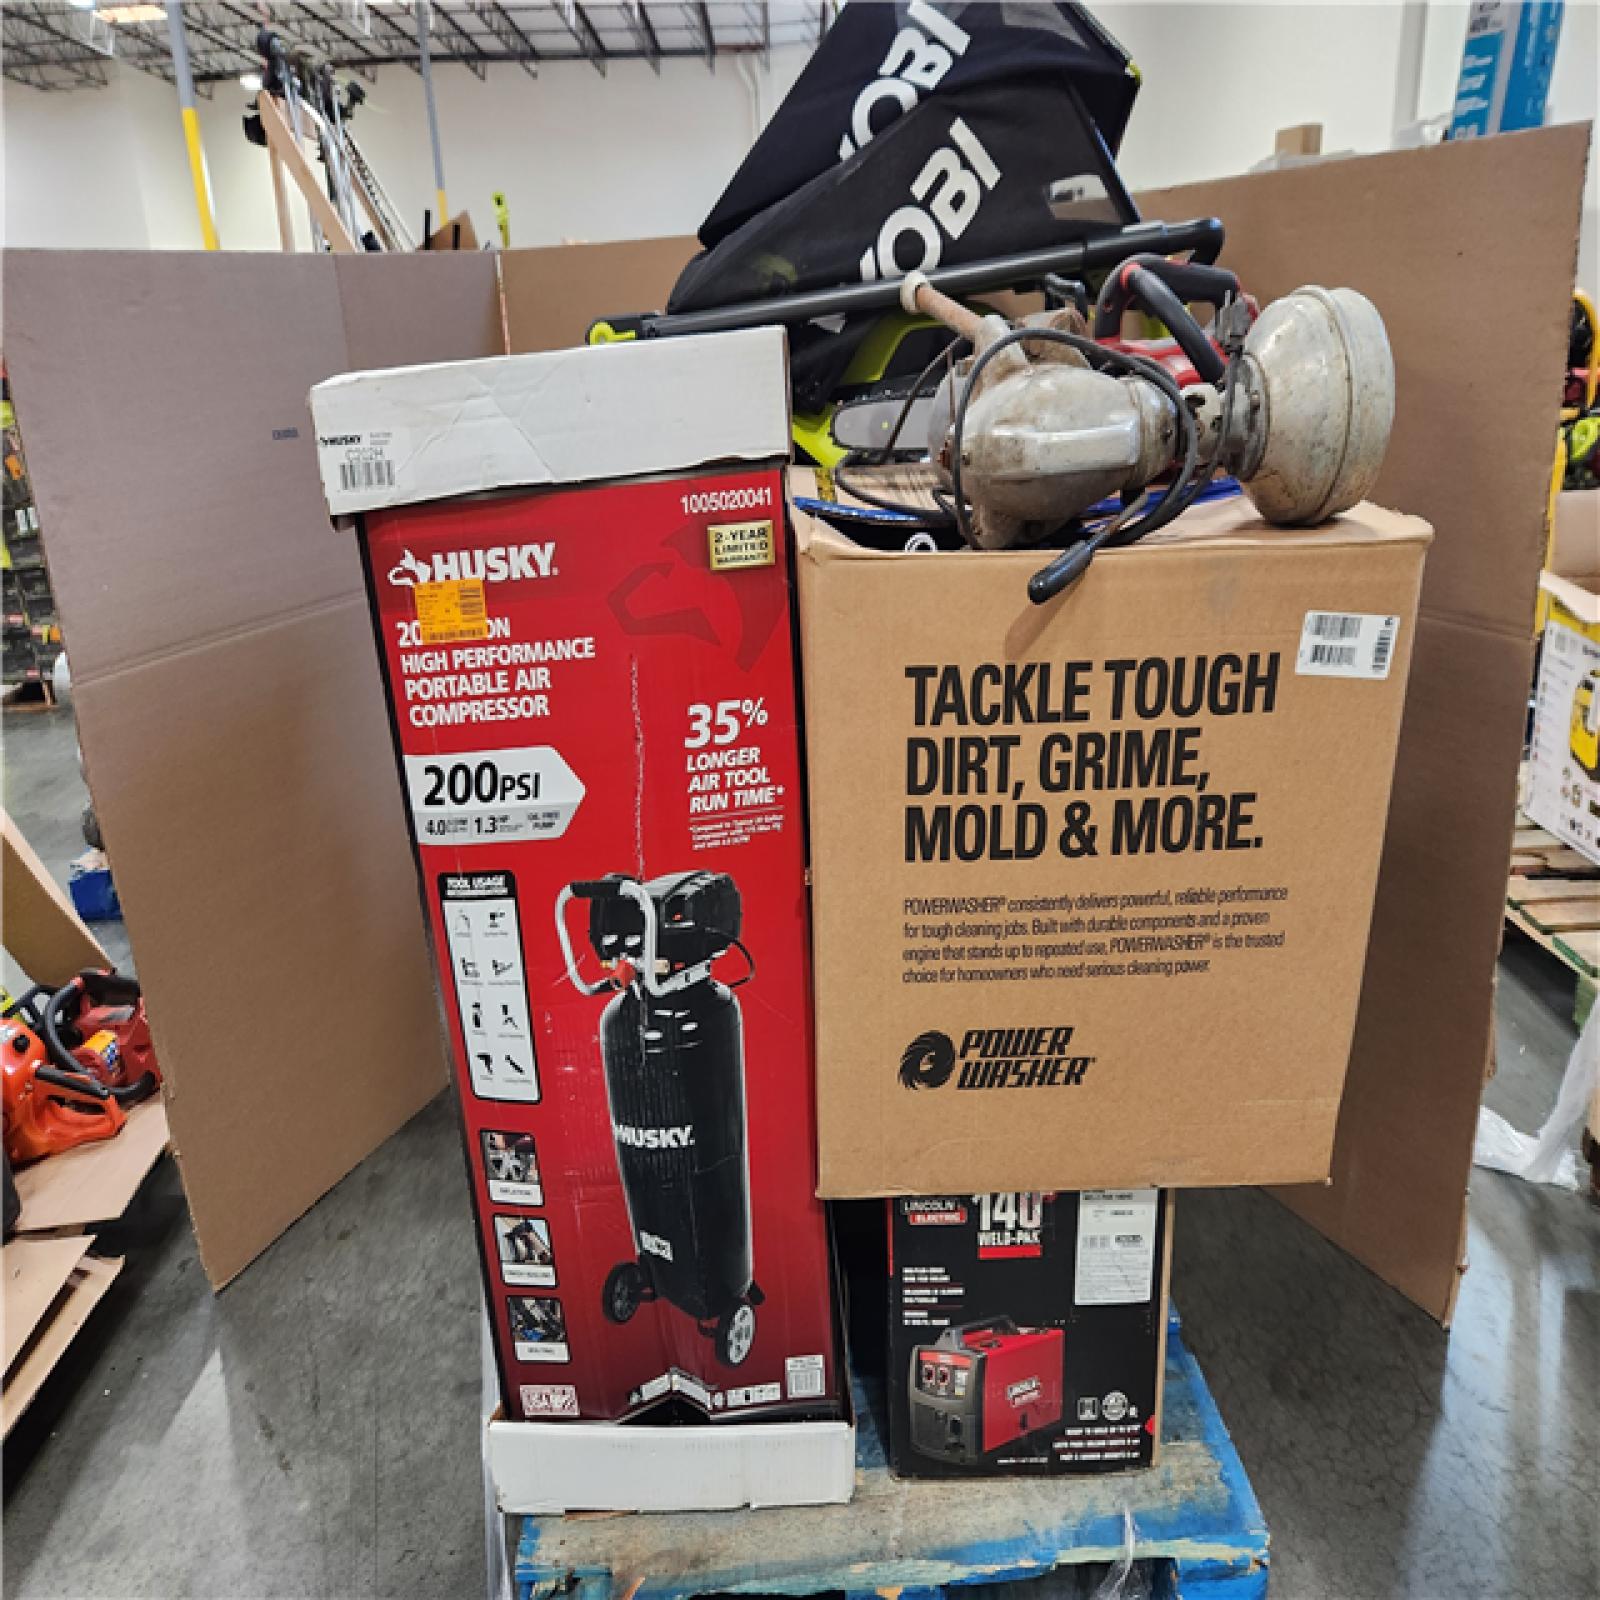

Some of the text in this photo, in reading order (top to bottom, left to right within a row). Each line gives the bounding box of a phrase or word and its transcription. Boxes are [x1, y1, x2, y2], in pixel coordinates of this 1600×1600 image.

[840, 1, 971, 161] OBI
[860, 117, 1001, 281] OBI
[681, 487, 772, 515] 1005020041
[714, 527, 768, 543] 2-YEAR
[714, 541, 768, 555] LIMITED
[432, 542, 556, 582] HUSKY
[400, 637, 596, 673] HIGH PERFORMANCE
[404, 667, 552, 701] PORTABLE AIR
[904, 652, 1281, 727] TACKLE TOUGH
[409, 694, 551, 726] COMPRESSOR
[684, 696, 769, 748] 35%
[687, 746, 761, 772] LONGER
[905, 727, 1210, 801] DIRT, GRIME,
[687, 767, 771, 793] AIR TOOL
[689, 792, 729, 814] RUN
[474, 815, 496, 836] 1.3
[903, 791, 1264, 863] MOLD & MORE.
[1007, 894, 1073, 912] consistently
[1074, 891, 1118, 908] delivers
[1174, 887, 1216, 906] reliable
[1217, 885, 1289, 905] performance
[904, 921, 918, 938] for
[922, 921, 953, 941] tough
[955, 920, 1001, 940] cleaning
[1032, 917, 1058, 935] Built
[1059, 917, 1086, 934] with
[1087, 914, 1129, 932] durable
[1130, 912, 1196, 932] components
[1197, 909, 1221, 926] and
[1222, 913, 1231, 925] a
[1231, 911, 1271, 928] proven
[903, 945, 941, 965] engine
[942, 944, 966, 960] that
[966, 942, 1003, 960] stands
[1004, 946, 1021, 960] up
[1022, 943, 1033, 958] to
[1034, 940, 1084, 960] repeated
[1212, 933, 1223, 948] is
[1224, 931, 1243, 948] the
[1244, 930, 1286, 948] trusted
[902, 967, 938, 983] choice
[939, 966, 956, 983] for
[956, 966, 1028, 982] homeowners
[1029, 963, 1056, 978] who
[1057, 961, 1086, 978] need
[1087, 959, 1126, 977] serious
[1127, 957, 1173, 978] cleaning
[960, 1027, 1075, 1058] POWER
[614, 1125, 693, 1148] HUSKY
[972, 1192, 1041, 1231] 140
